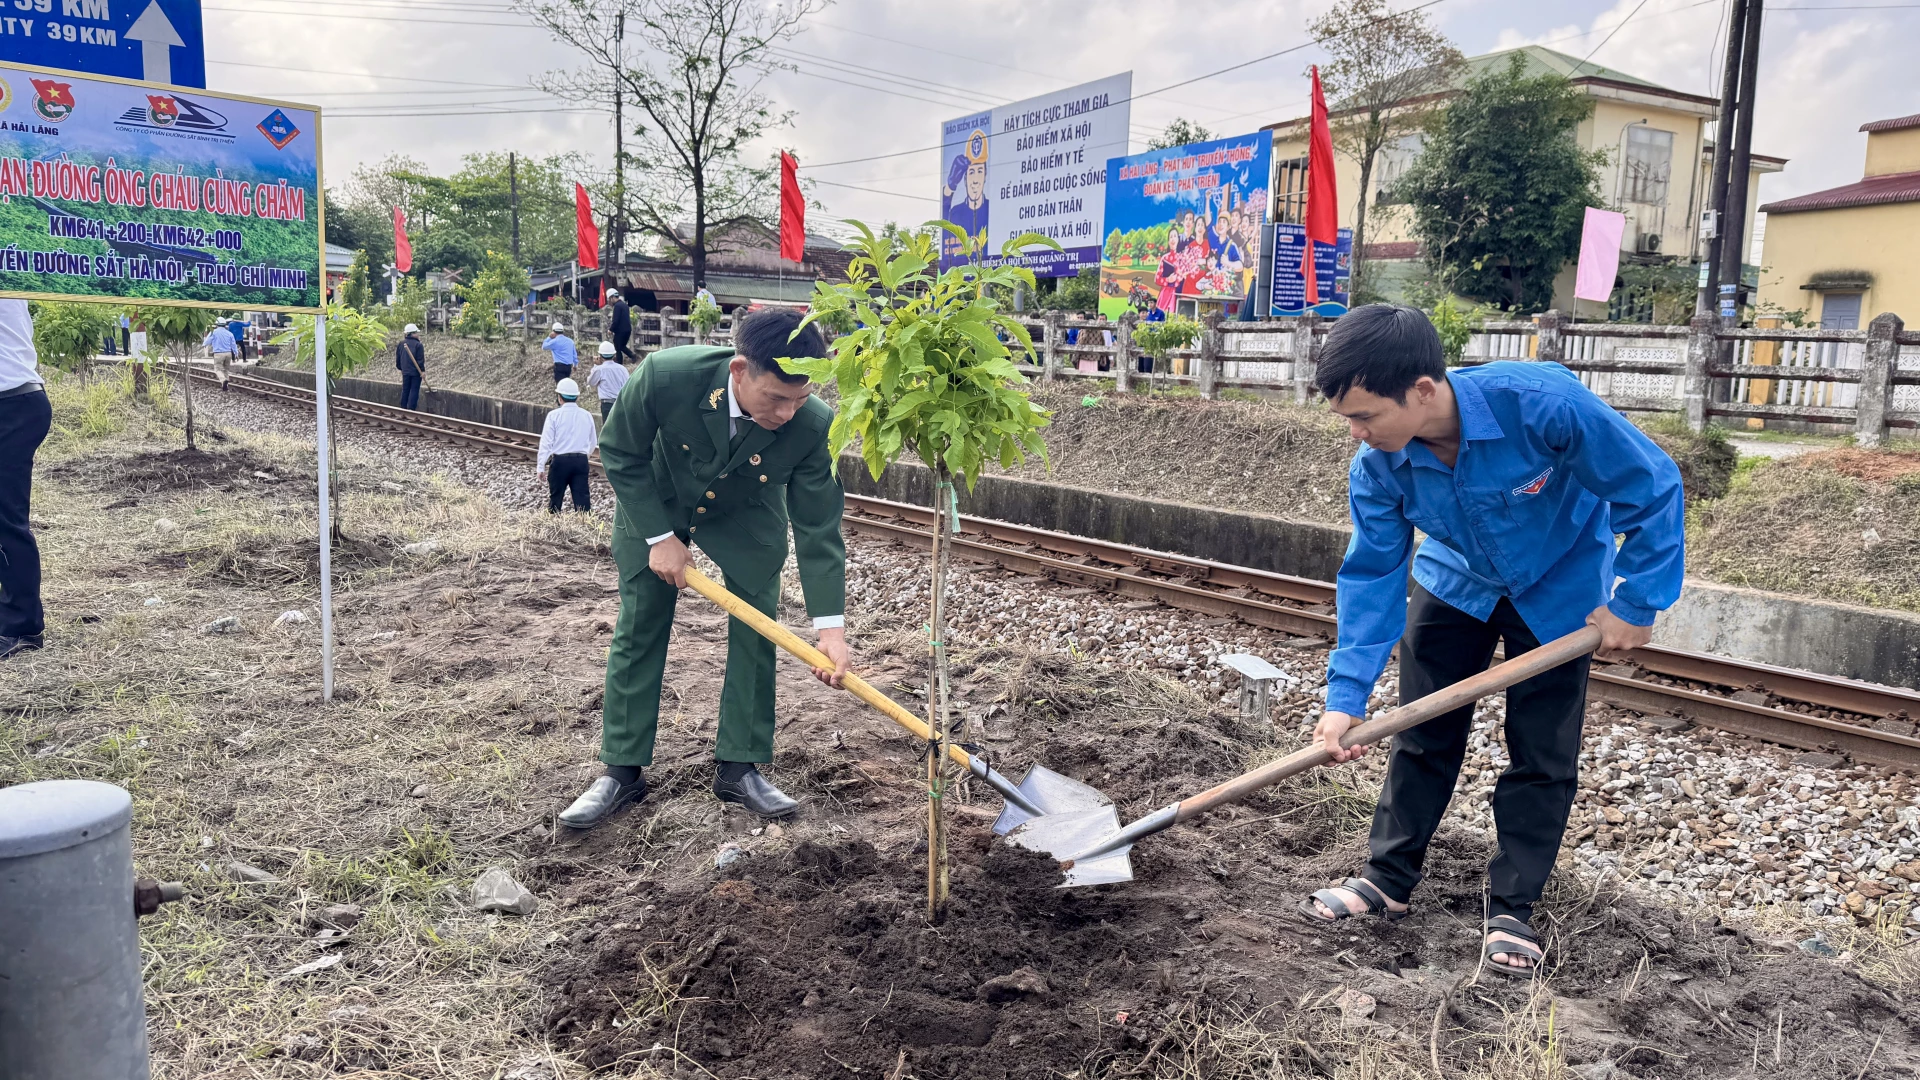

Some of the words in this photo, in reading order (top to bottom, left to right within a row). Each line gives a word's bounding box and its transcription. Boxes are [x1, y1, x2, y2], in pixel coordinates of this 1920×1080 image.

[62, 0, 109, 20] KM
[1004, 115, 1020, 131] HÃY
[1022, 110, 1041, 127] TÍCH
[1043, 105, 1061, 125] CỰC
[1064, 98, 1090, 117] THAM
[1093, 93, 1109, 110] GIA
[0, 120, 8, 130] Ã
[11, 121, 29, 133] HẢI
[32, 124, 59, 136] LĂNG
[115, 125, 133, 133] CÔNG
[1017, 132, 1033, 151] BẢO
[1036, 127, 1058, 148] HIỂM
[1060, 125, 1073, 143] XÃ
[1075, 120, 1091, 142] HỘI
[1021, 154, 1037, 174] BẢO
[1040, 150, 1063, 171] HIỂM
[1065, 151, 1072, 165] Y
[1073, 144, 1085, 163] TẾ
[1163, 155, 1181, 173] PHÁT
[1182, 155, 1196, 170] HUY
[1197, 147, 1225, 167] TRUYỀN
[32, 152, 101, 203] ĐƯỜNG
[105, 157, 145, 207] ÔNG
[150, 165, 199, 212] CHÁU
[203, 168, 251, 217] CÙNG
[255, 178, 305, 222] CHĂM
[1000, 181, 1011, 200] ĐỂ
[1012, 179, 1031, 198] ĐẢM
[1033, 176, 1050, 195] BẢO
[1053, 172, 1078, 192] CUỘC
[1081, 166, 1107, 187] SỐNG
[1143, 180, 1161, 197] ĐOÀN
[1177, 174, 1194, 191] PHÁT
[1019, 206, 1035, 220] CHO
[1038, 201, 1055, 217] BẢN
[1058, 197, 1083, 214] THÂN
[1048, 222, 1059, 239] VÀ
[1062, 223, 1073, 238] XÃ
[1076, 221, 1092, 239] HỘI
[33, 248, 90, 276] ĐƯỜNG
[95, 249, 125, 278] SẮT
[129, 255, 151, 280] HÀ
[154, 256, 182, 286] NỘI
[196, 258, 237, 286] TP.HỒ
[241, 263, 265, 287] CHÍ
[268, 267, 307, 289] MINH
[1038, 251, 1065, 264] QUẢNG
[1065, 252, 1079, 263] TRỊ
